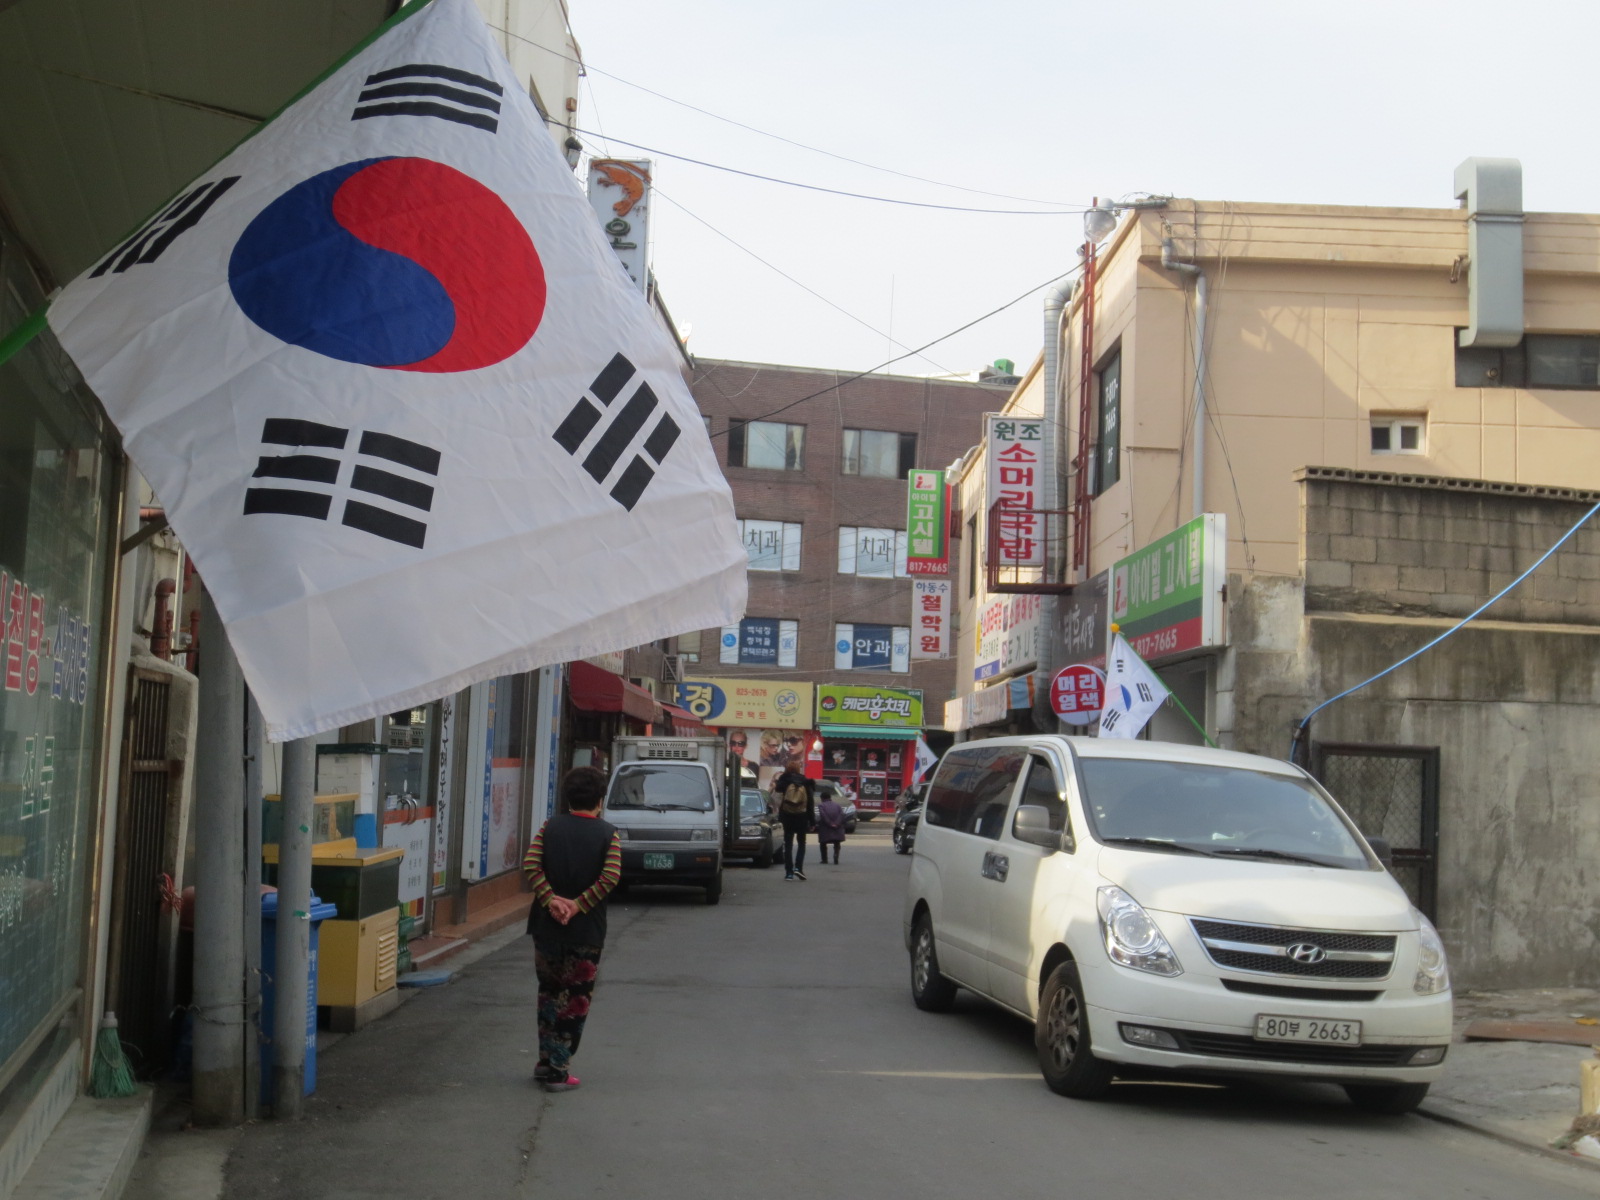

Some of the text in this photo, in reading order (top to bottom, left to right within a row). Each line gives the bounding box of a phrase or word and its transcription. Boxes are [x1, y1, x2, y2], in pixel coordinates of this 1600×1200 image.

[995, 422, 1041, 441] 원조
[911, 493, 937, 502] 아이빌
[997, 443, 1038, 560] 소머리국밥
[912, 504, 934, 554] 고시텔
[748, 528, 780, 555] 치과
[861, 536, 892, 562] 치과
[909, 561, 948, 573] 817-7665
[1131, 527, 1201, 608] 아이빌 고시텔
[915, 582, 948, 593] 하동수
[920, 595, 941, 653] 철학원
[855, 639, 891, 657] 안과
[1136, 628, 1177, 656] 817-7665
[51, 606, 91, 706] 삼계탕
[1058, 674, 1098, 691] 머리
[1058, 693, 1099, 711] 염색
[1266, 1019, 1352, 1041] 80부 2663
